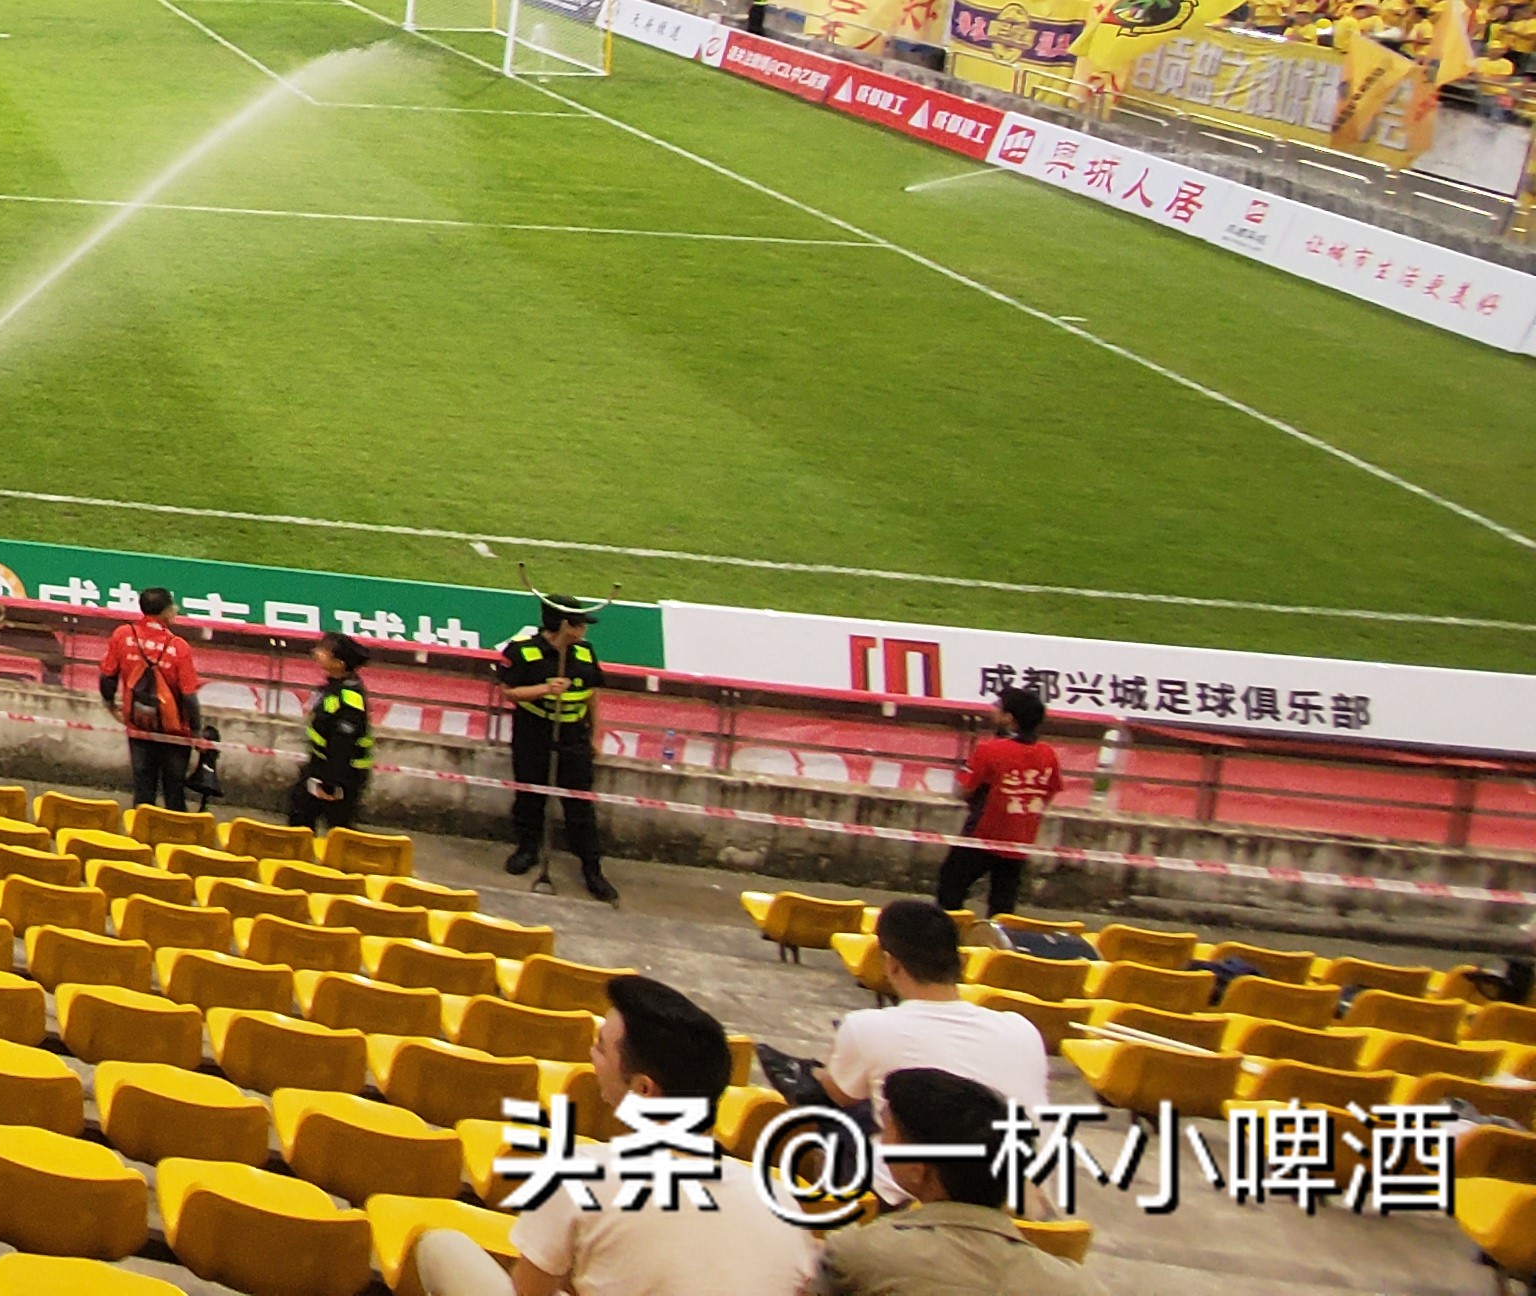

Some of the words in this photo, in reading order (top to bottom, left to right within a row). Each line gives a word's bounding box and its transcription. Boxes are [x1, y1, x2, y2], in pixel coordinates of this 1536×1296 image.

[979, 662, 1372, 731] 成都兴城足球俱乐部
